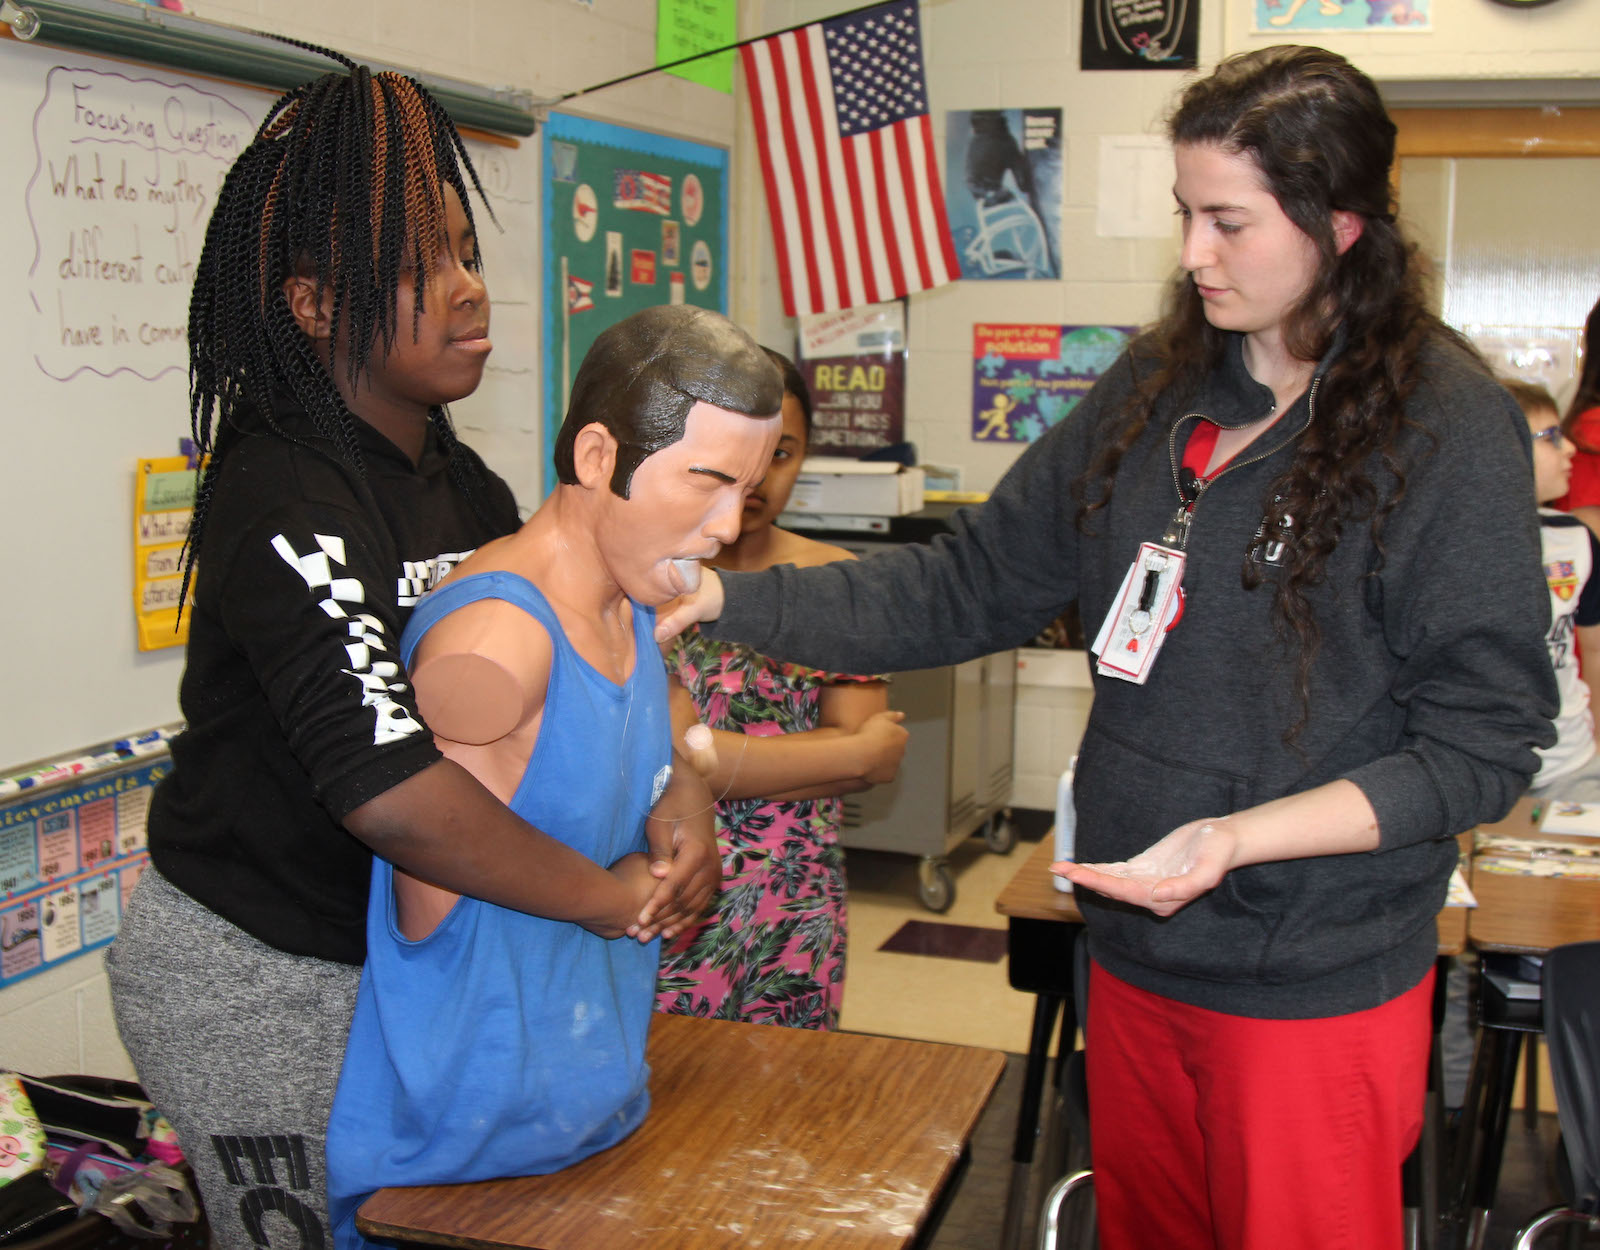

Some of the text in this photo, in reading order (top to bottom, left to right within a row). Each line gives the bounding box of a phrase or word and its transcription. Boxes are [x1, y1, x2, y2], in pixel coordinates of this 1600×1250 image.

[72, 82, 162, 182] Focusing
[49, 152, 105, 201] What
[114, 158, 139, 202] do
[149, 160, 208, 231] myths
[59, 224, 144, 284] different
[57, 288, 104, 346] have
[112, 314, 130, 345] in
[815, 364, 887, 391] READ
[0, 777, 138, 827] ievements
